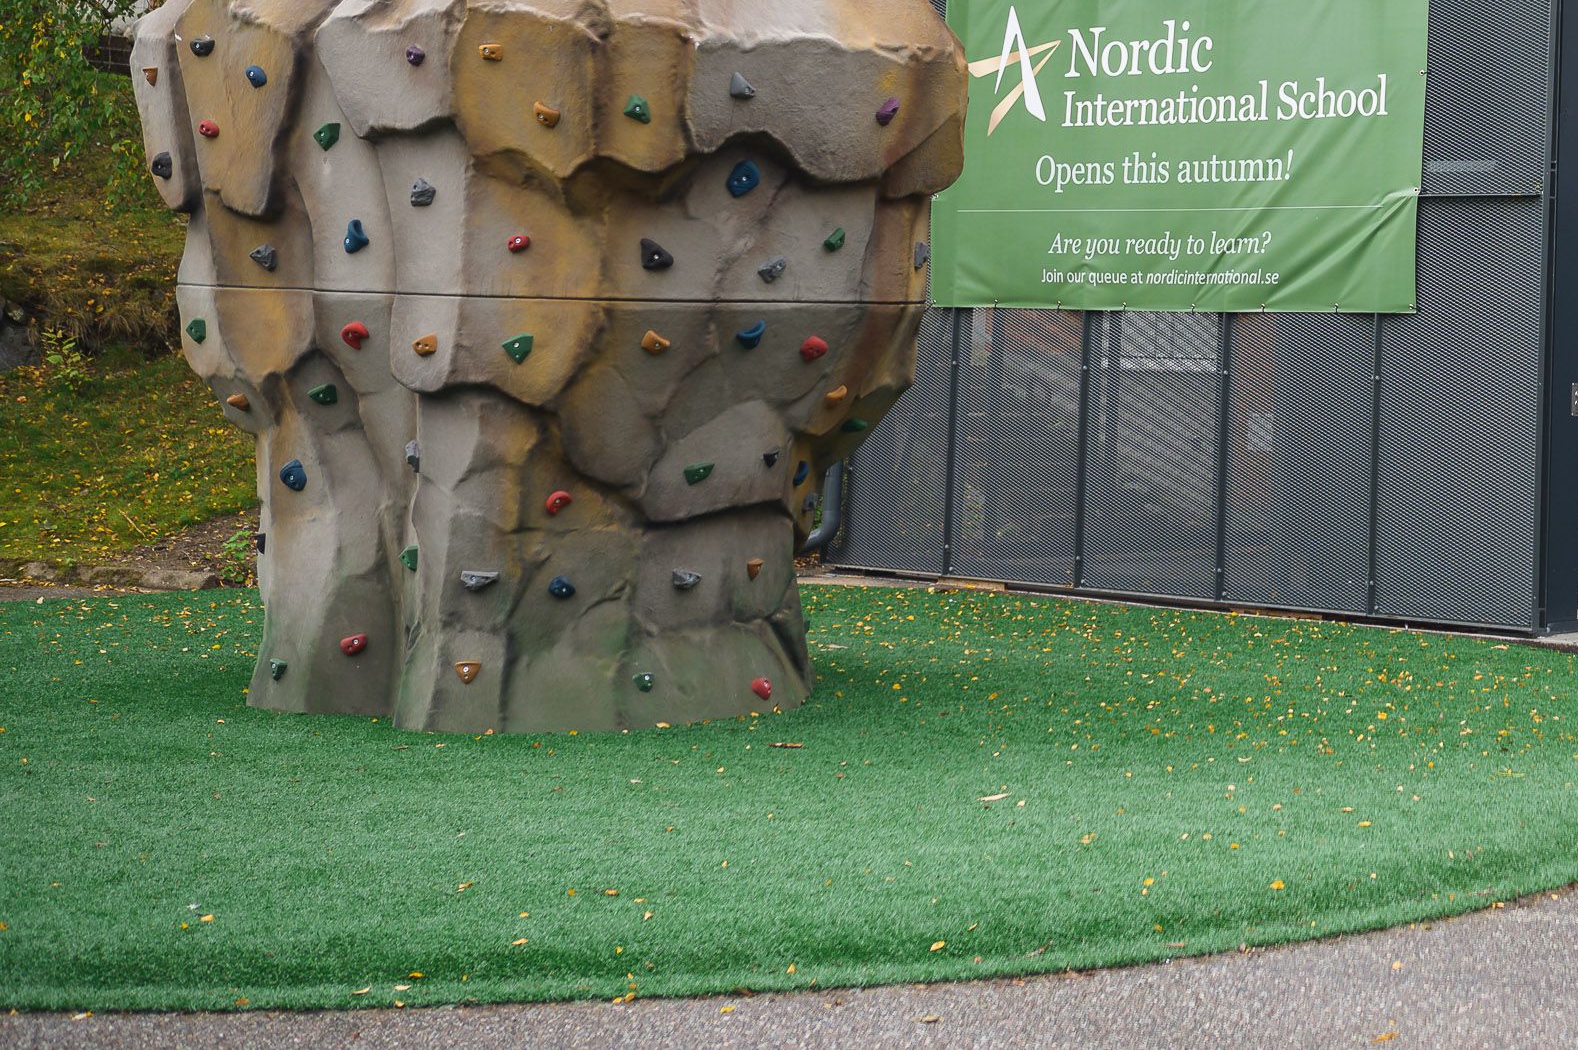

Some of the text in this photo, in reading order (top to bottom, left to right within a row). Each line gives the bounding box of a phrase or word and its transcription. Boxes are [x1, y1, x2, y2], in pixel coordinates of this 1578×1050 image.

[1064, 20, 1213, 78] Nordic
[1061, 73, 1389, 127] International School
[1035, 149, 1294, 193] Opens this autumn!
[1048, 230, 1272, 262] Are you ready to learn?
[1041, 268, 1280, 287] Join our queue at nordicinternational.se
